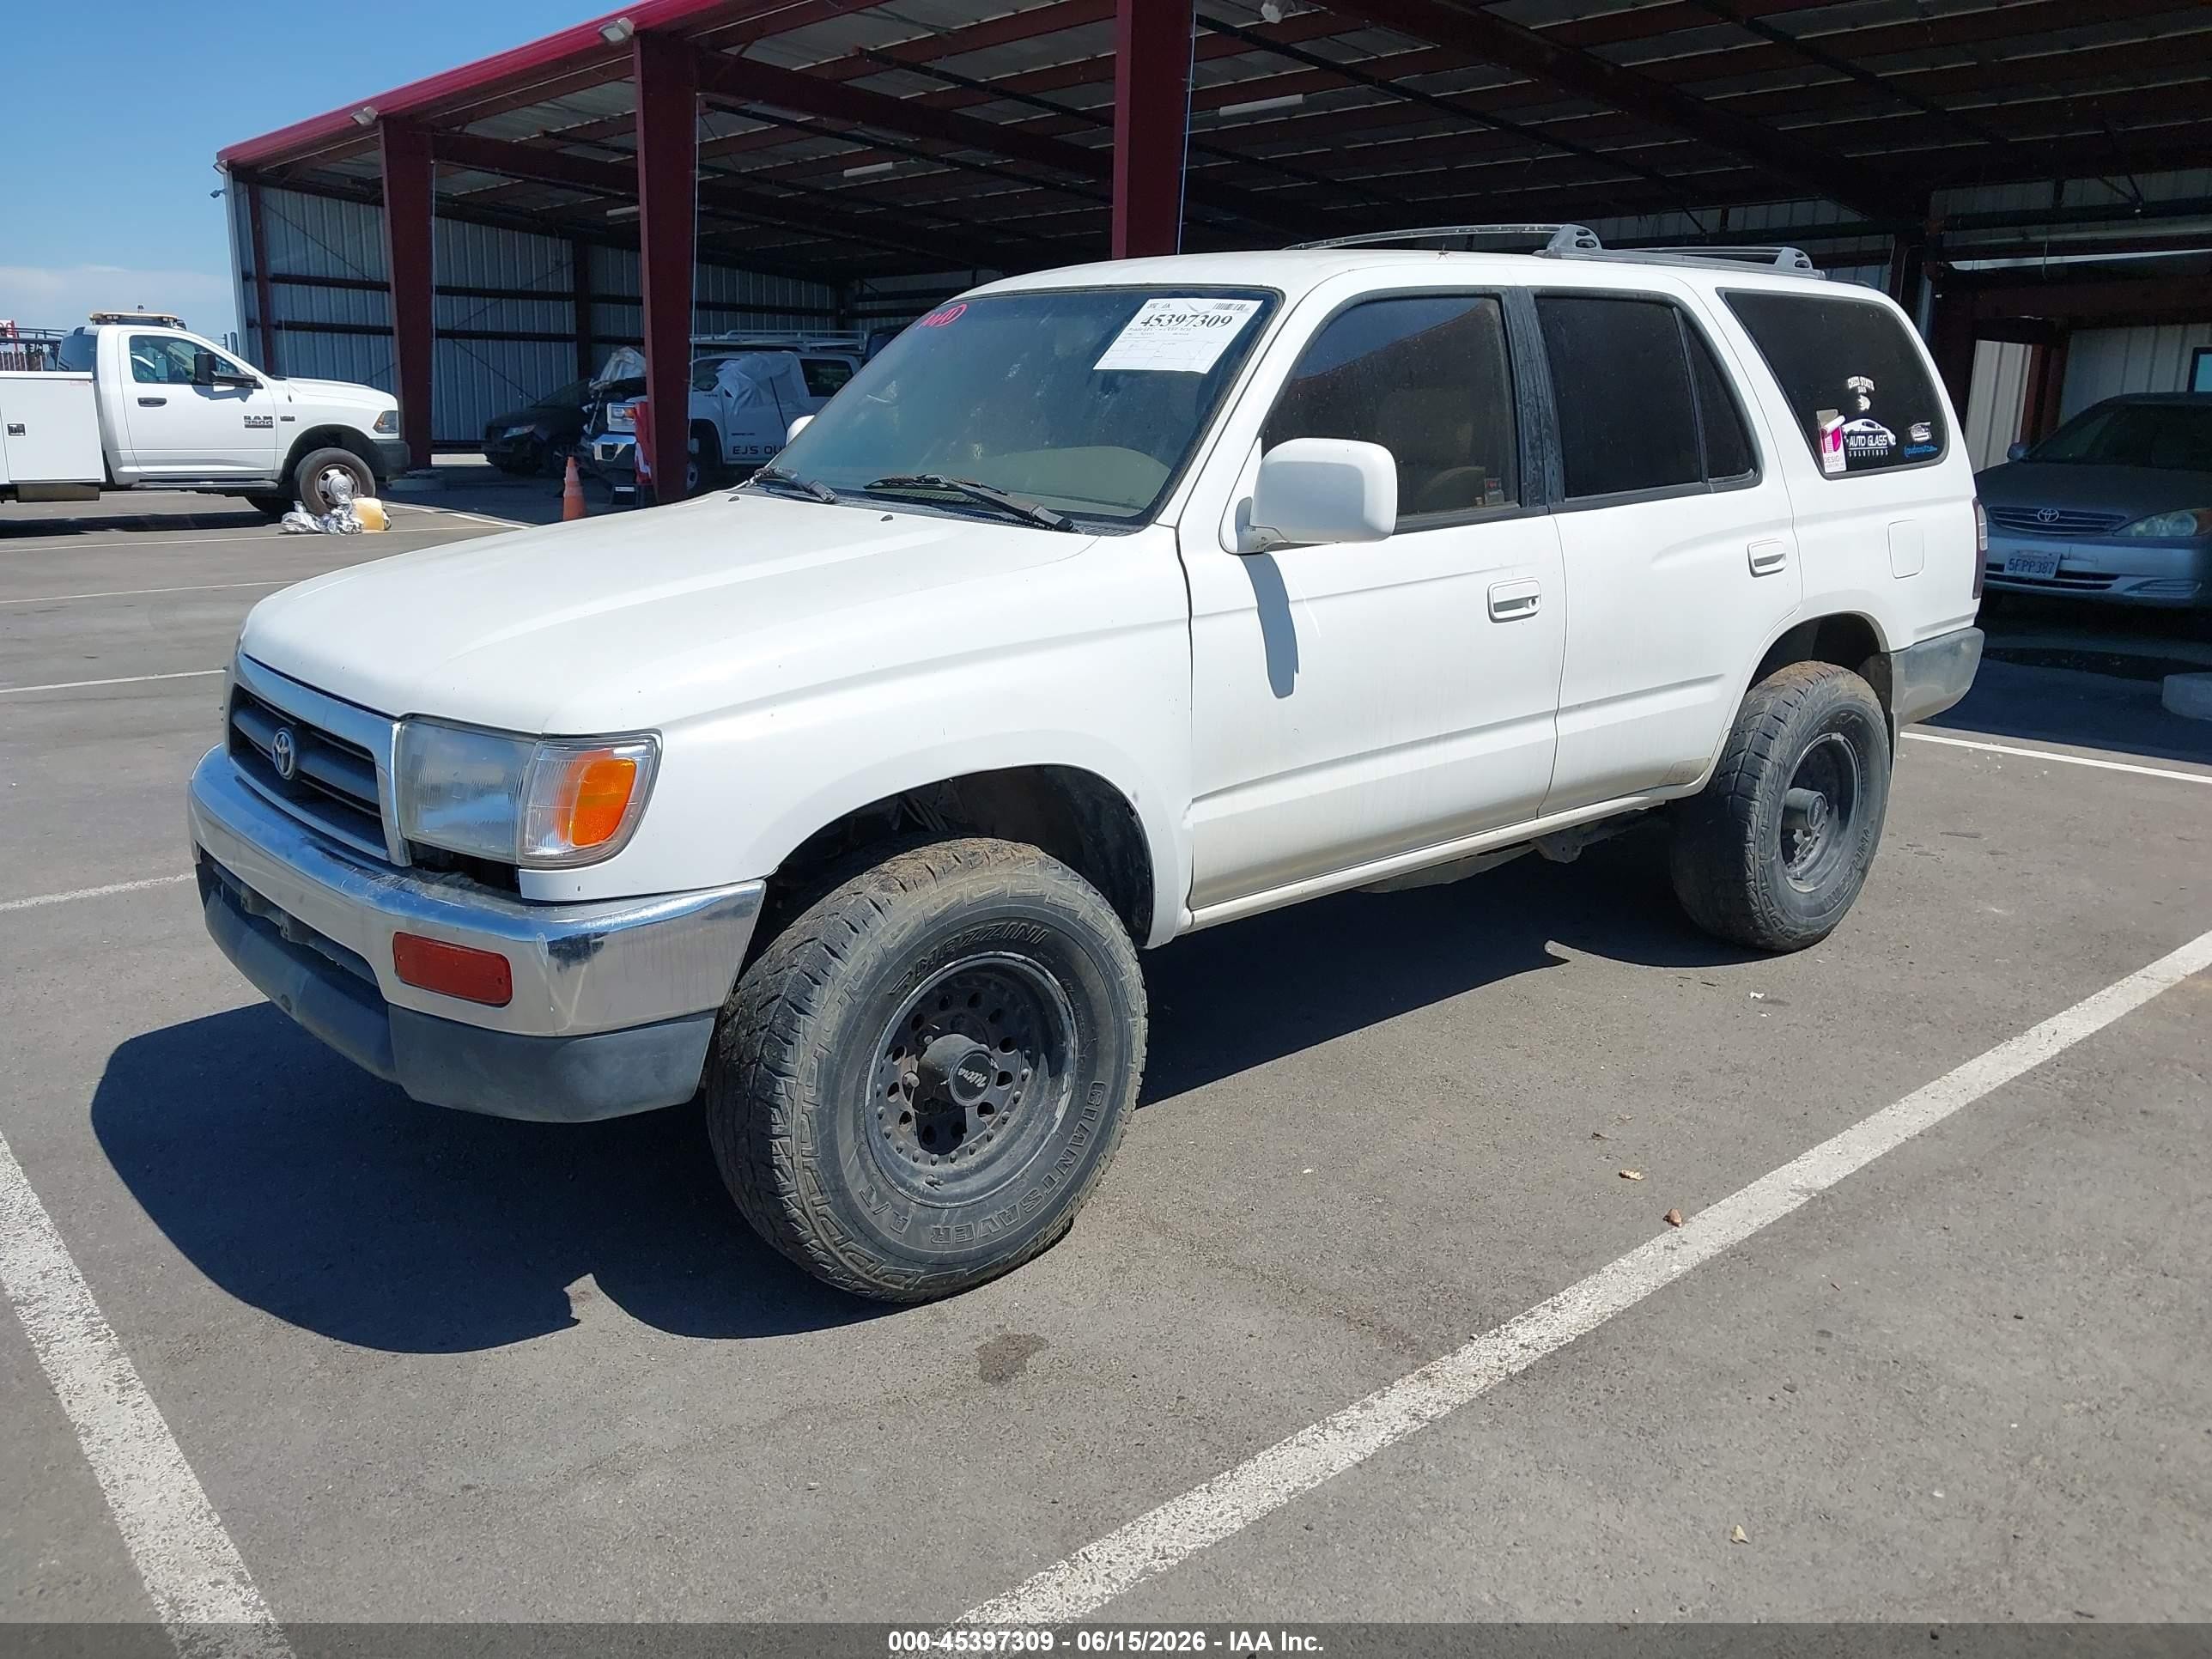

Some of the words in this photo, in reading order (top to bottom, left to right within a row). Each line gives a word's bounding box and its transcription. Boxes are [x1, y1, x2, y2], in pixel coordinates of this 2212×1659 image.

[1140, 313, 1233, 328] 45397309
[1849, 435, 1866, 447] AUTO
[1867, 434, 1887, 447] GLASS
[732, 446, 759, 455] EJS
[930, 1080, 1106, 1244] GIANTSAVER
[859, 1184, 913, 1235] A/T
